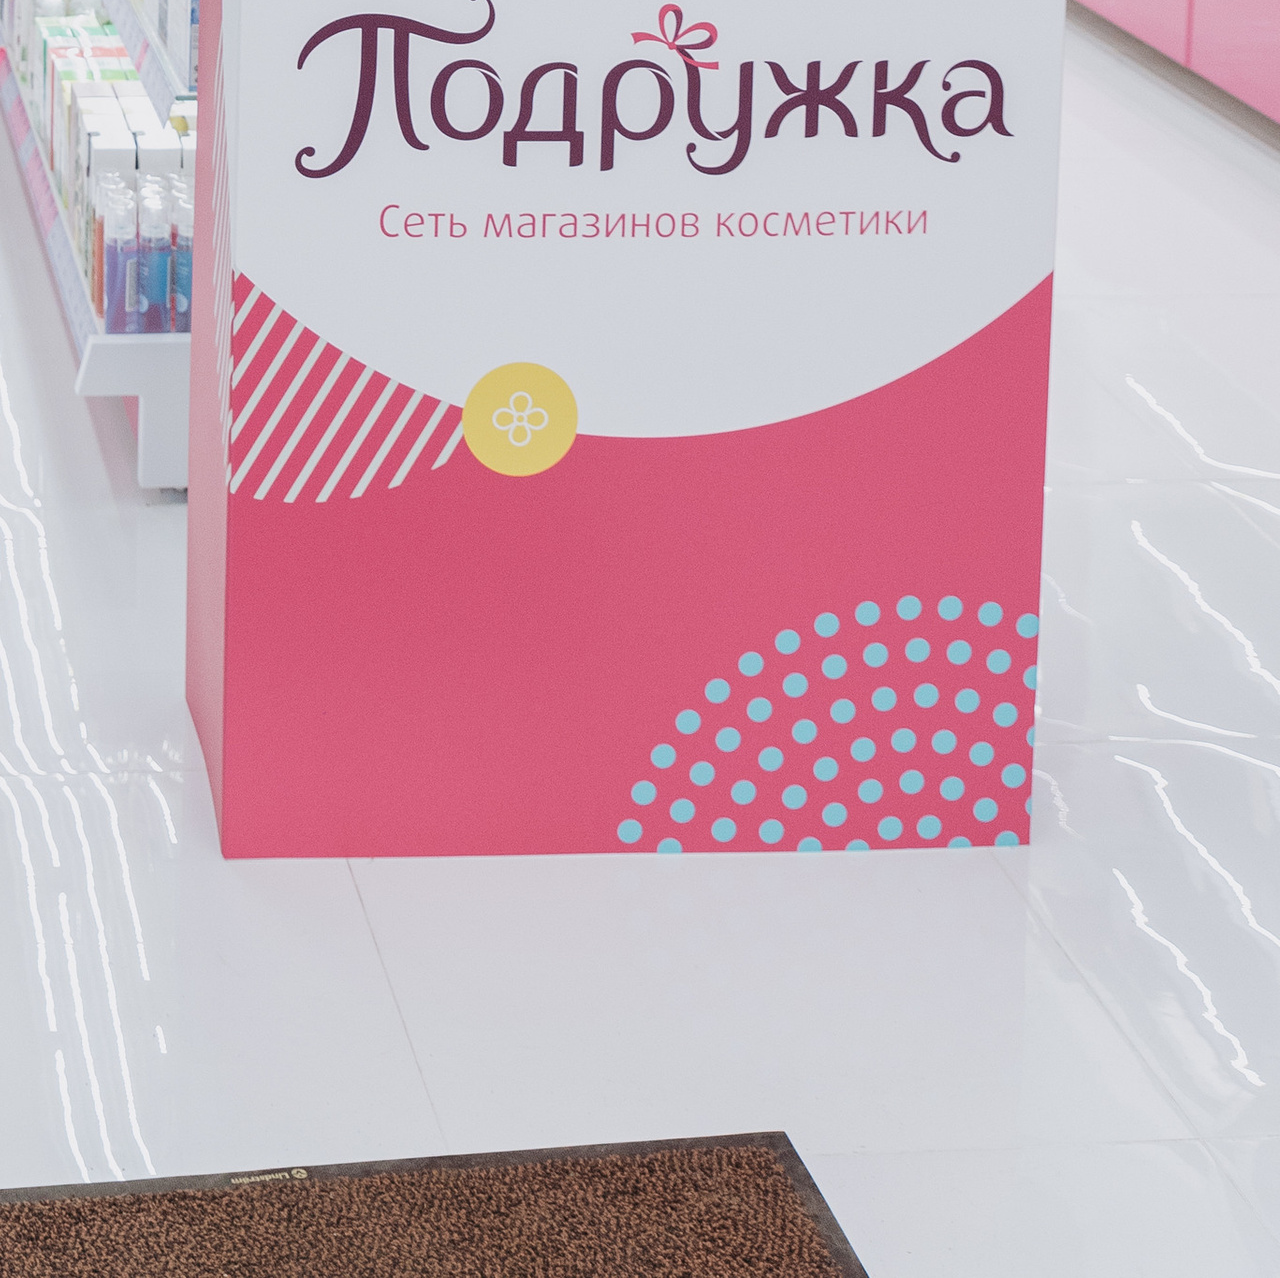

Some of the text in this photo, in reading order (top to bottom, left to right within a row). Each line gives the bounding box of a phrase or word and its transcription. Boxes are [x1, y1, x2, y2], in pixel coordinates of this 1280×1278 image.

[379, 203, 929, 240] Сеть магазинов косметики
